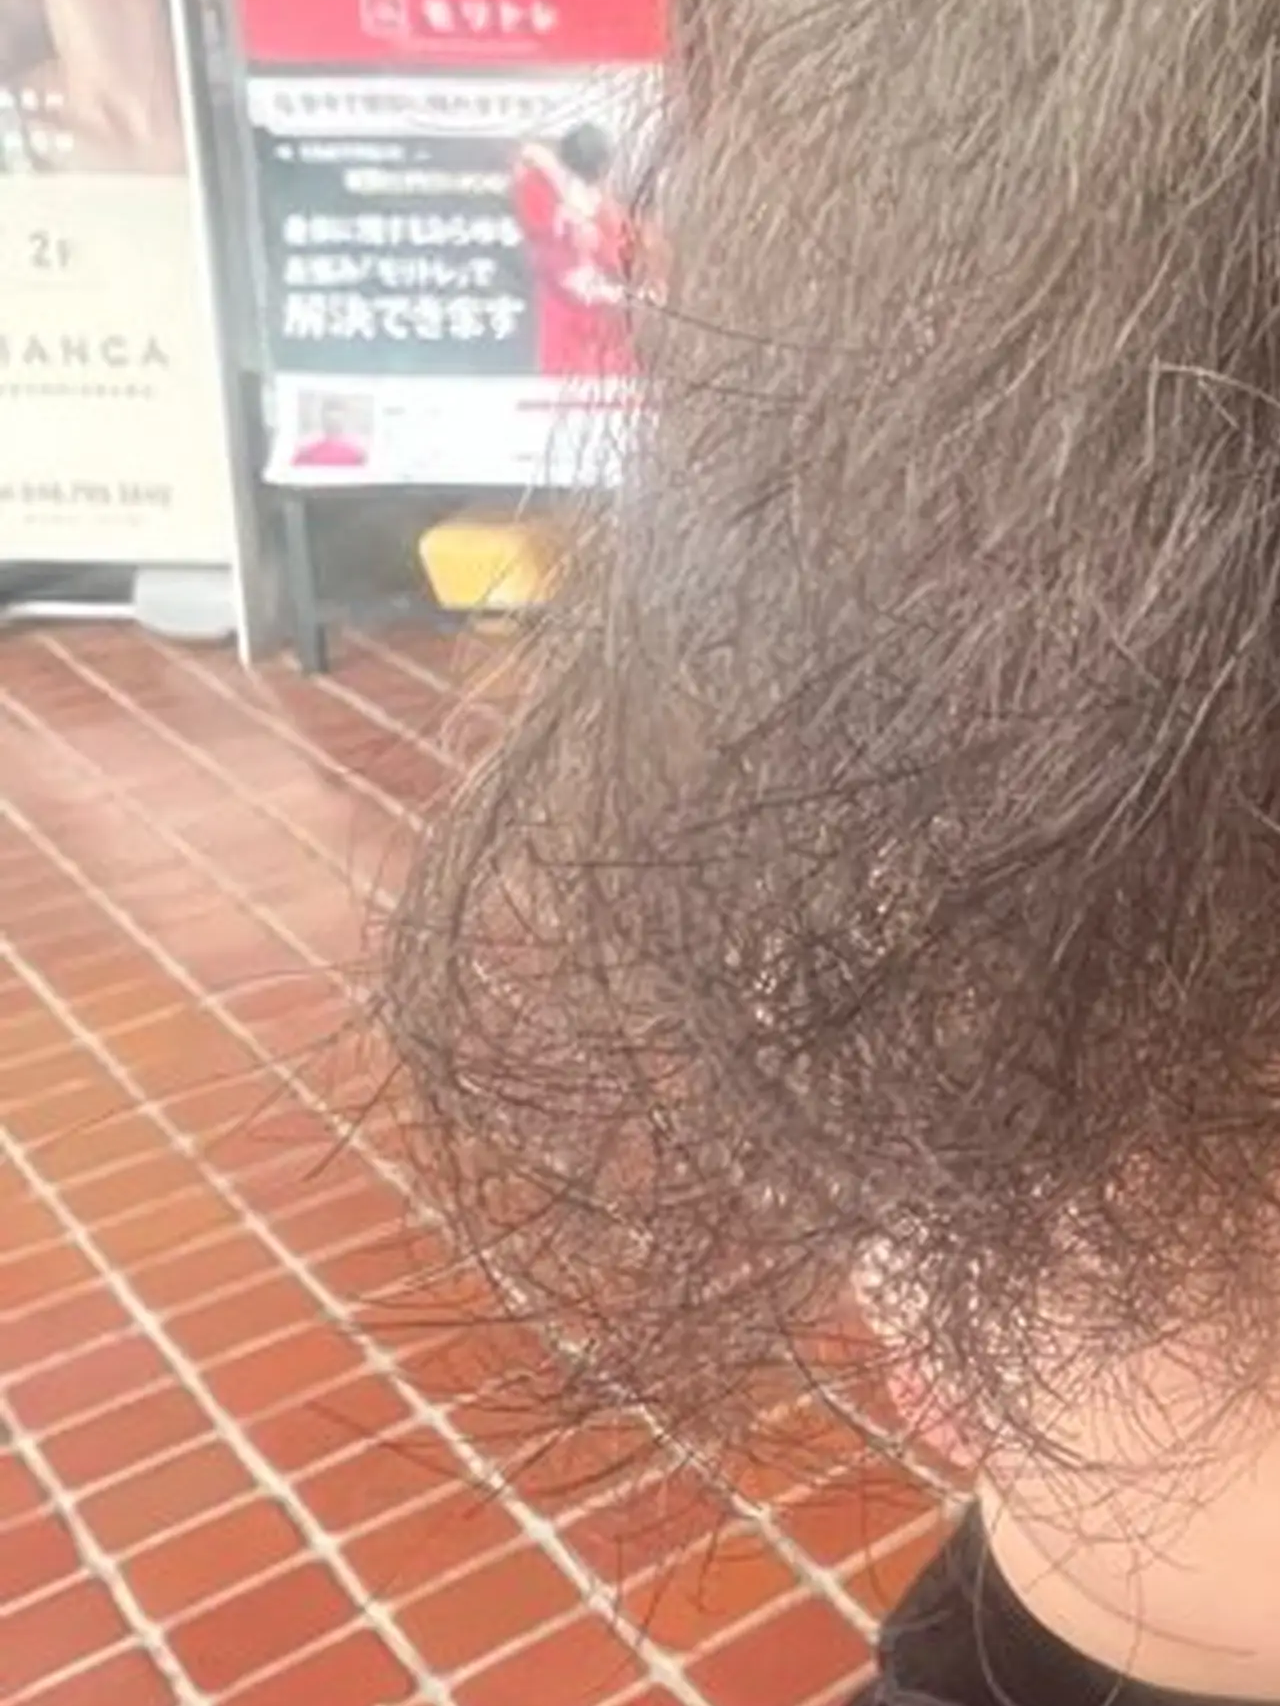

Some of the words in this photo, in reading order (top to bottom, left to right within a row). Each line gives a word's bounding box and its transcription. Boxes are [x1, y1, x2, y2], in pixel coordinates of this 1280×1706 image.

[283, 293, 526, 340] 解決できます
